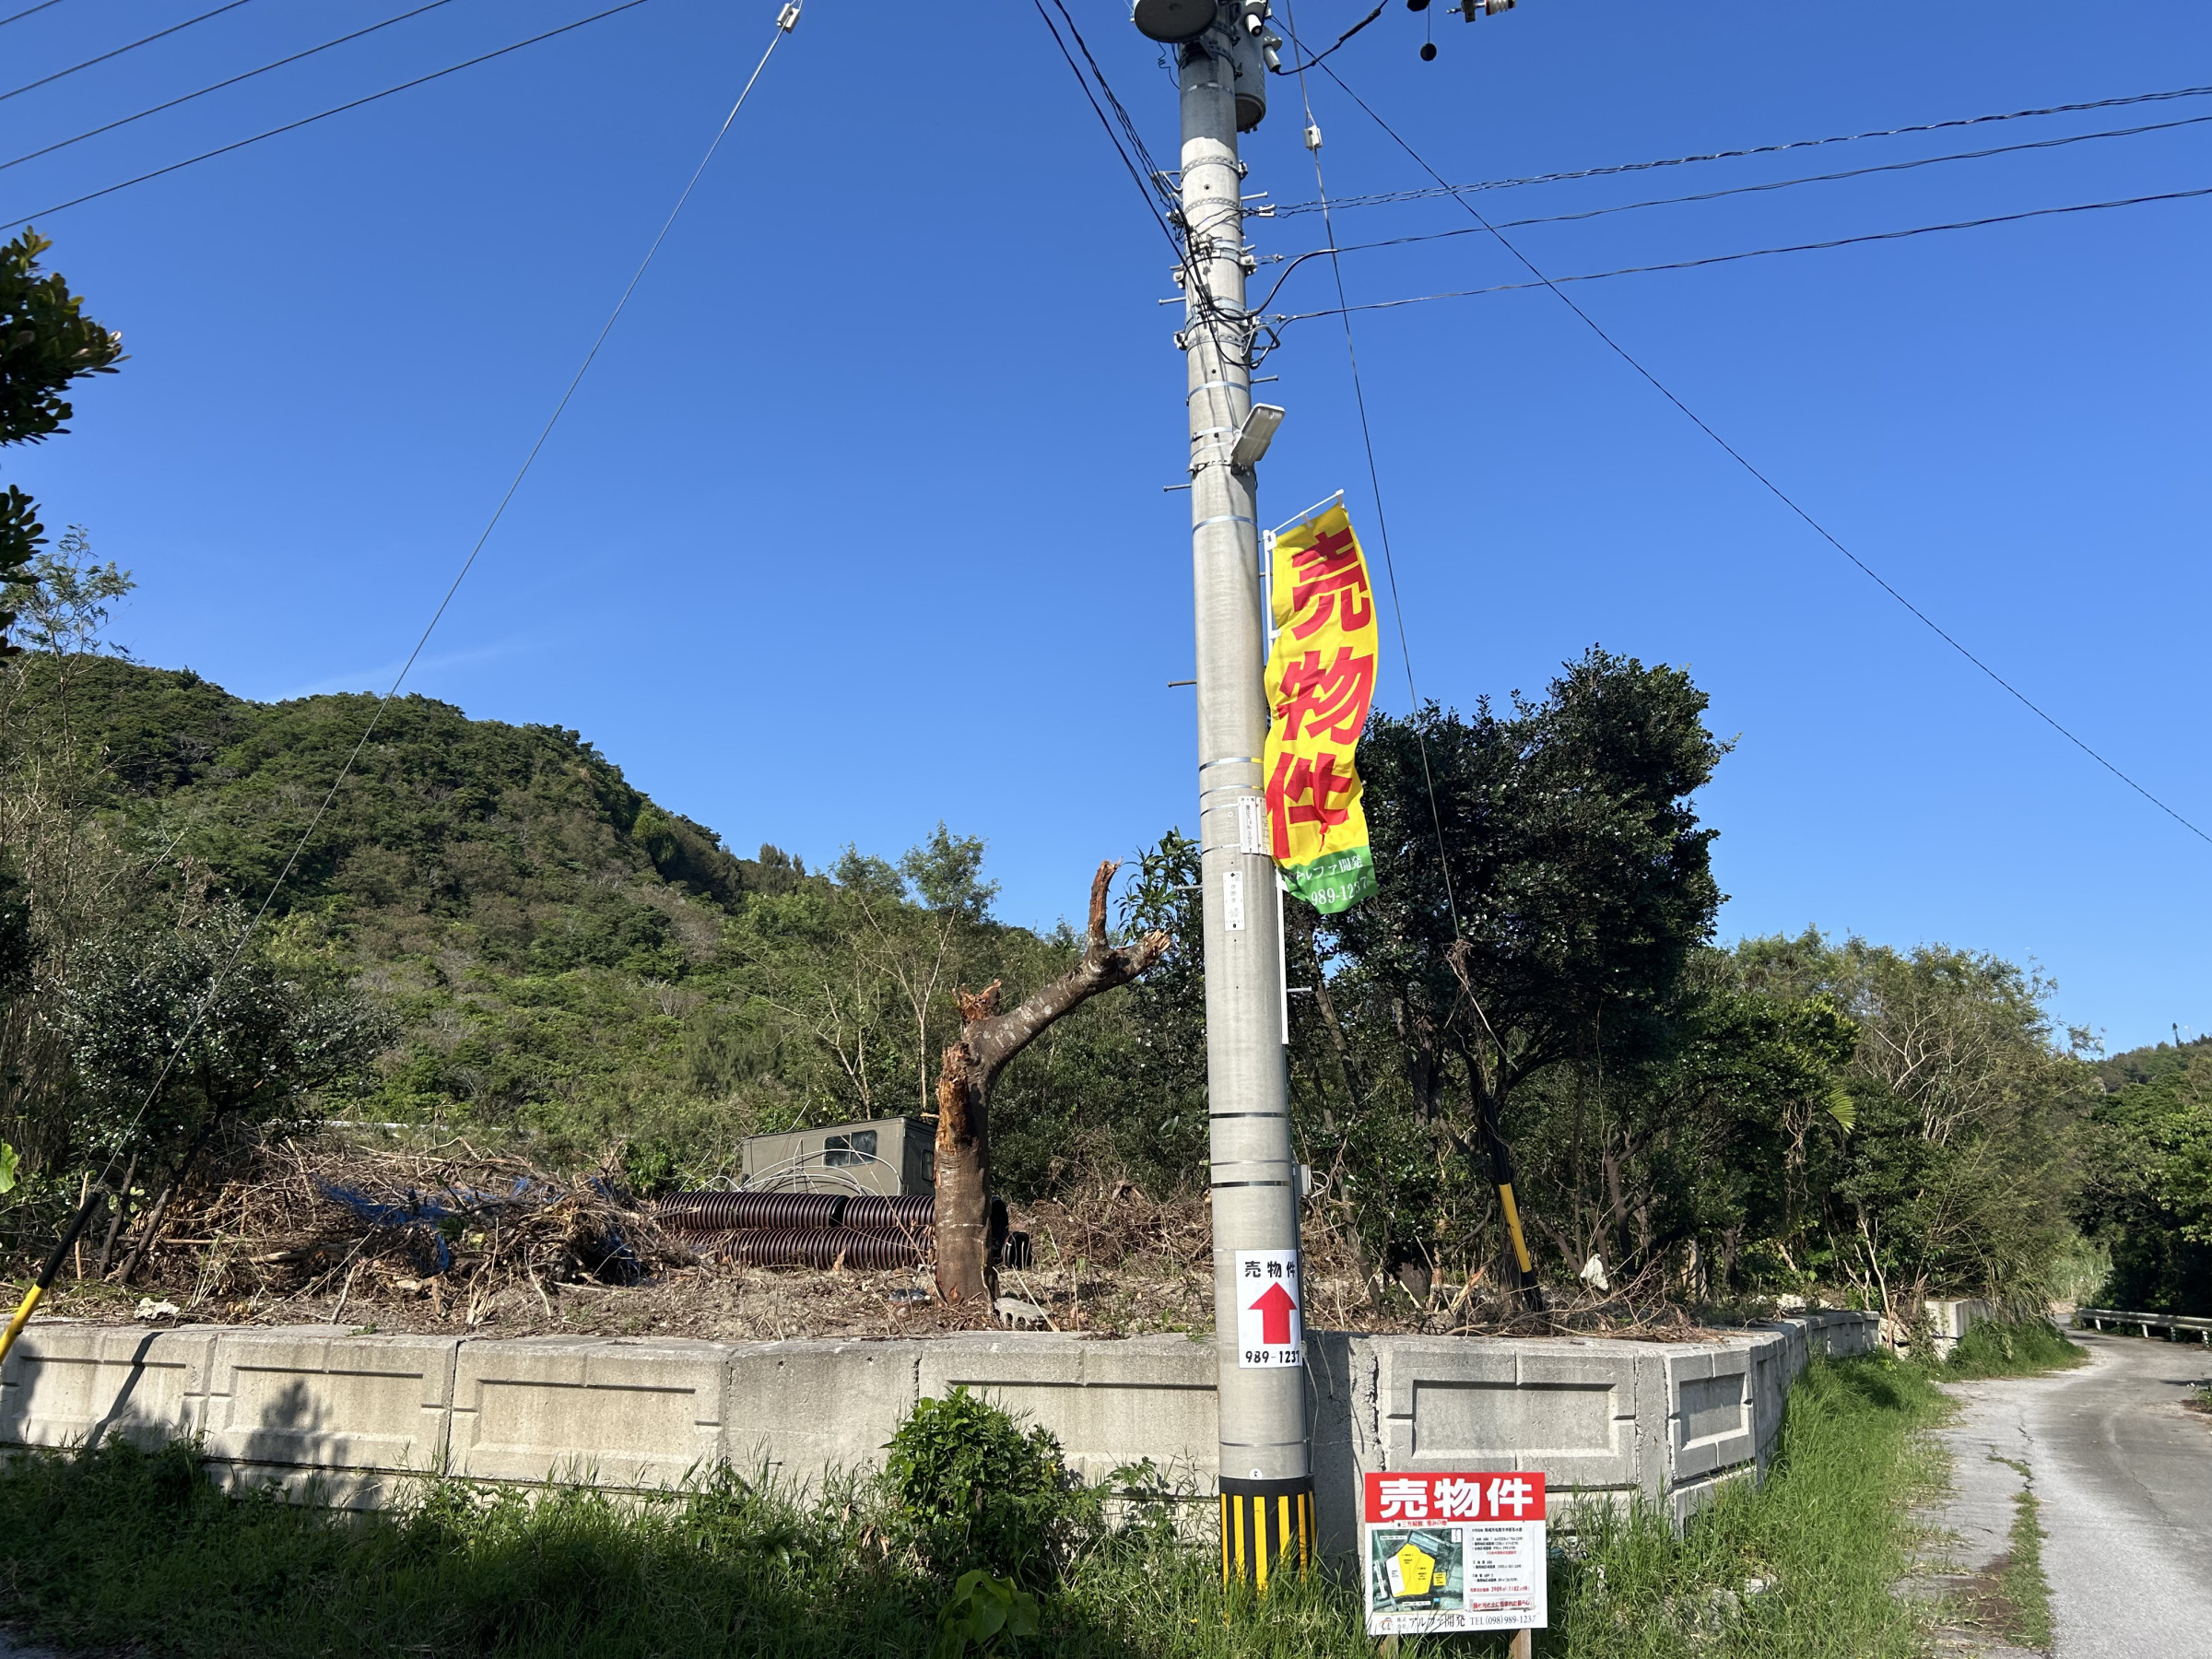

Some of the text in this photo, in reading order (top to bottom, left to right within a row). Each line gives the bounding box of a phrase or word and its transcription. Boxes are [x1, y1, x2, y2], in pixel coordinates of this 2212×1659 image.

[1266, 531, 1372, 859] 売物件
[1311, 877, 1367, 907] 989-1237
[1244, 1260, 1296, 1278] 売物件
[1379, 1477, 1534, 1519] 売物件
